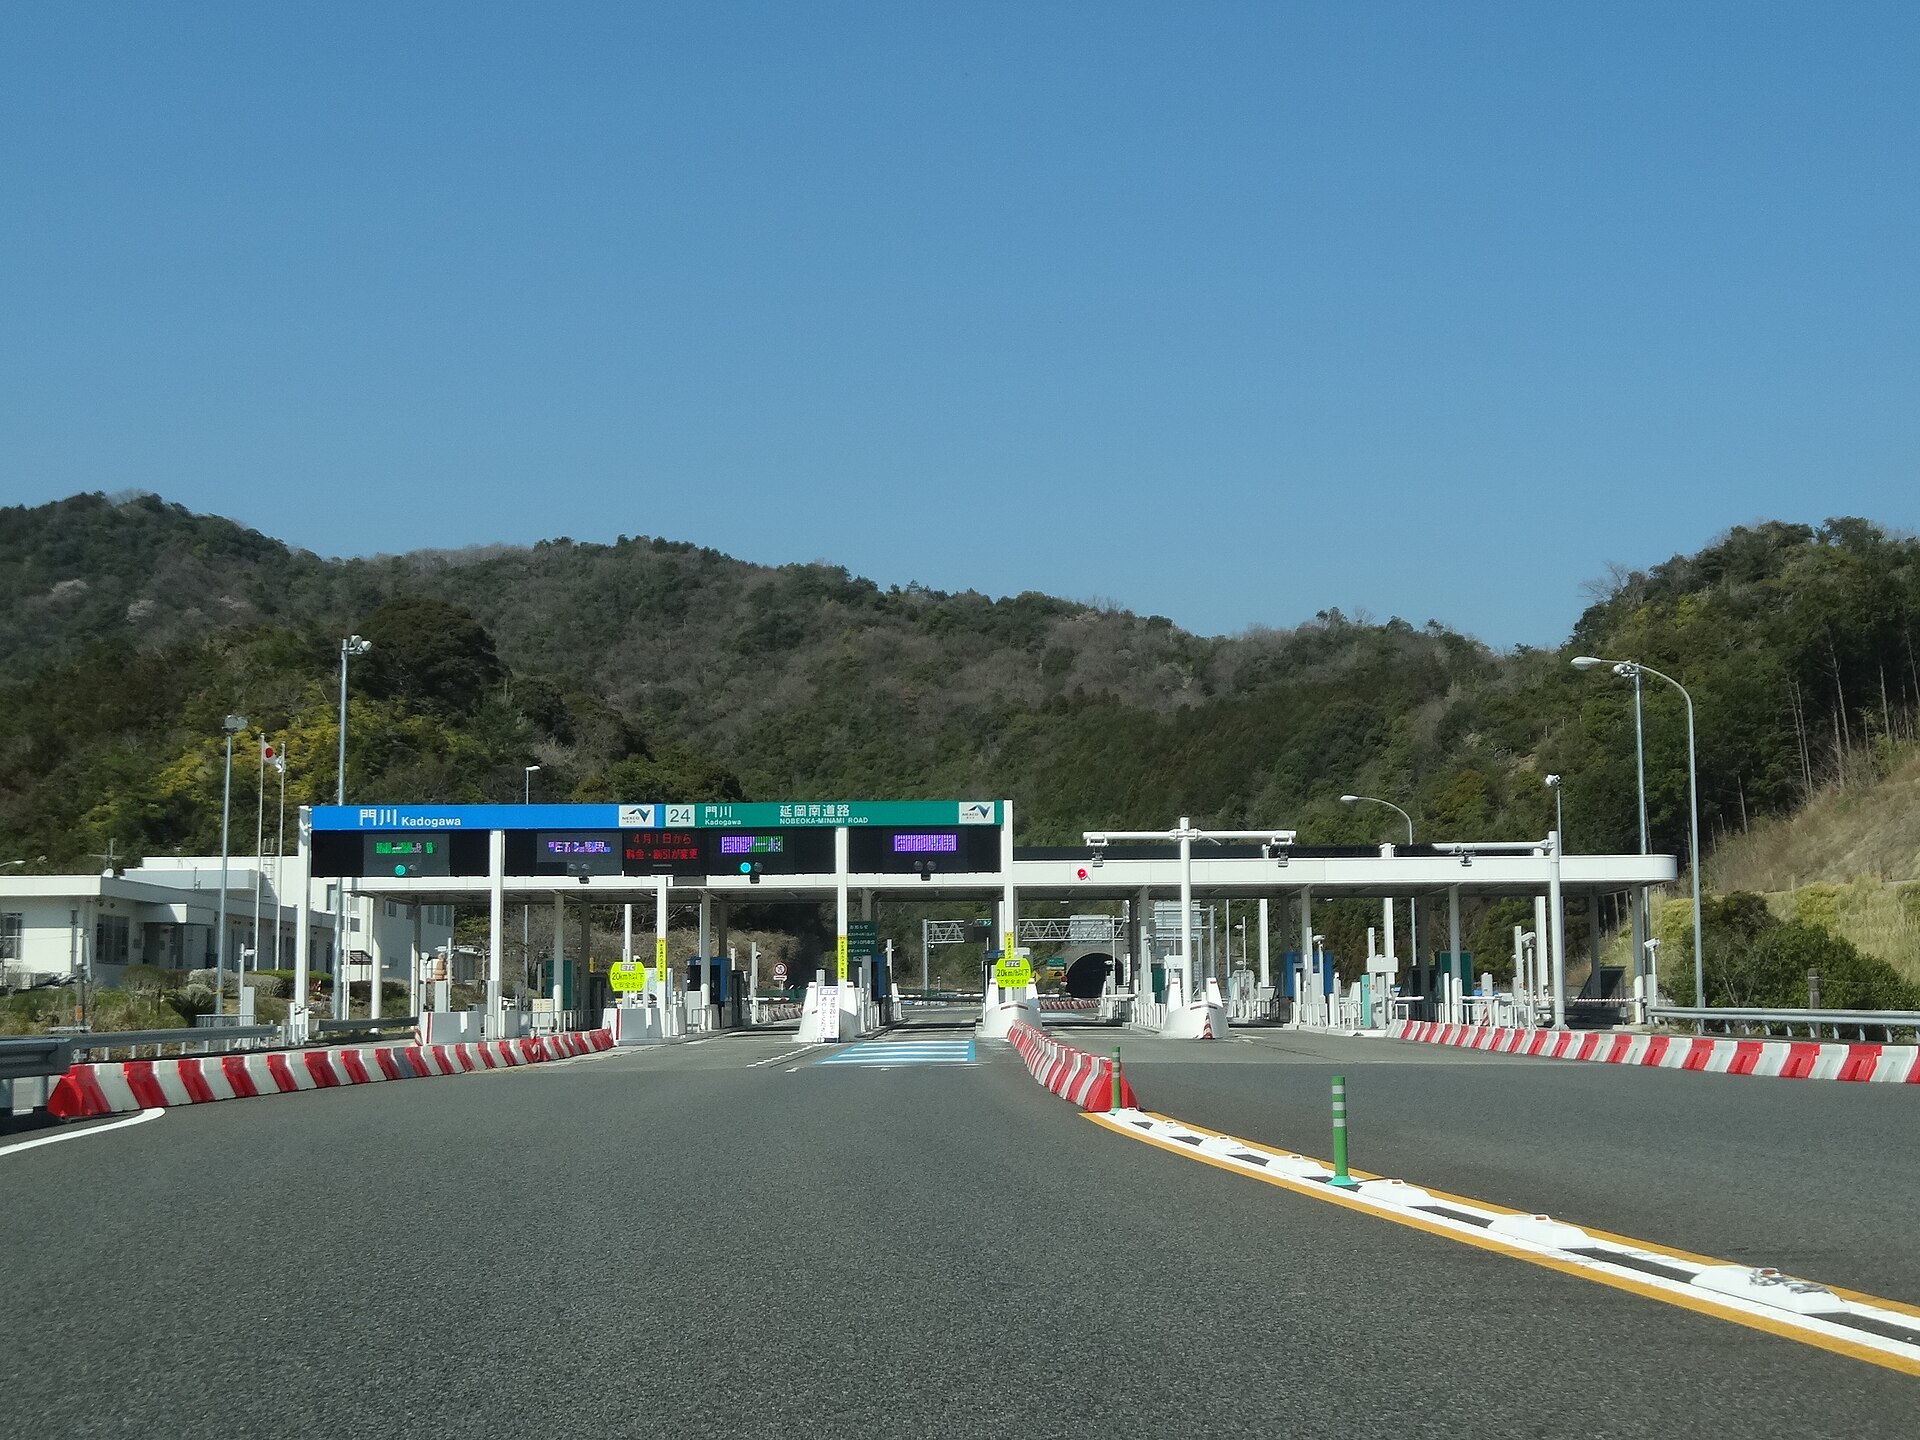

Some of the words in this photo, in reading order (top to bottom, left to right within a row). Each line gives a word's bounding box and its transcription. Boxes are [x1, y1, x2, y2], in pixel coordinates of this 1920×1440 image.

[670, 808, 691, 823] 24
[705, 805, 732, 818] 門川
[779, 804, 850, 817] 延岡南道路
[359, 808, 397, 826] 門川
[401, 816, 461, 828] Kadogawa
[779, 817, 845, 825] NOBEOKA-MINAMI
[847, 816, 869, 824] ROAD
